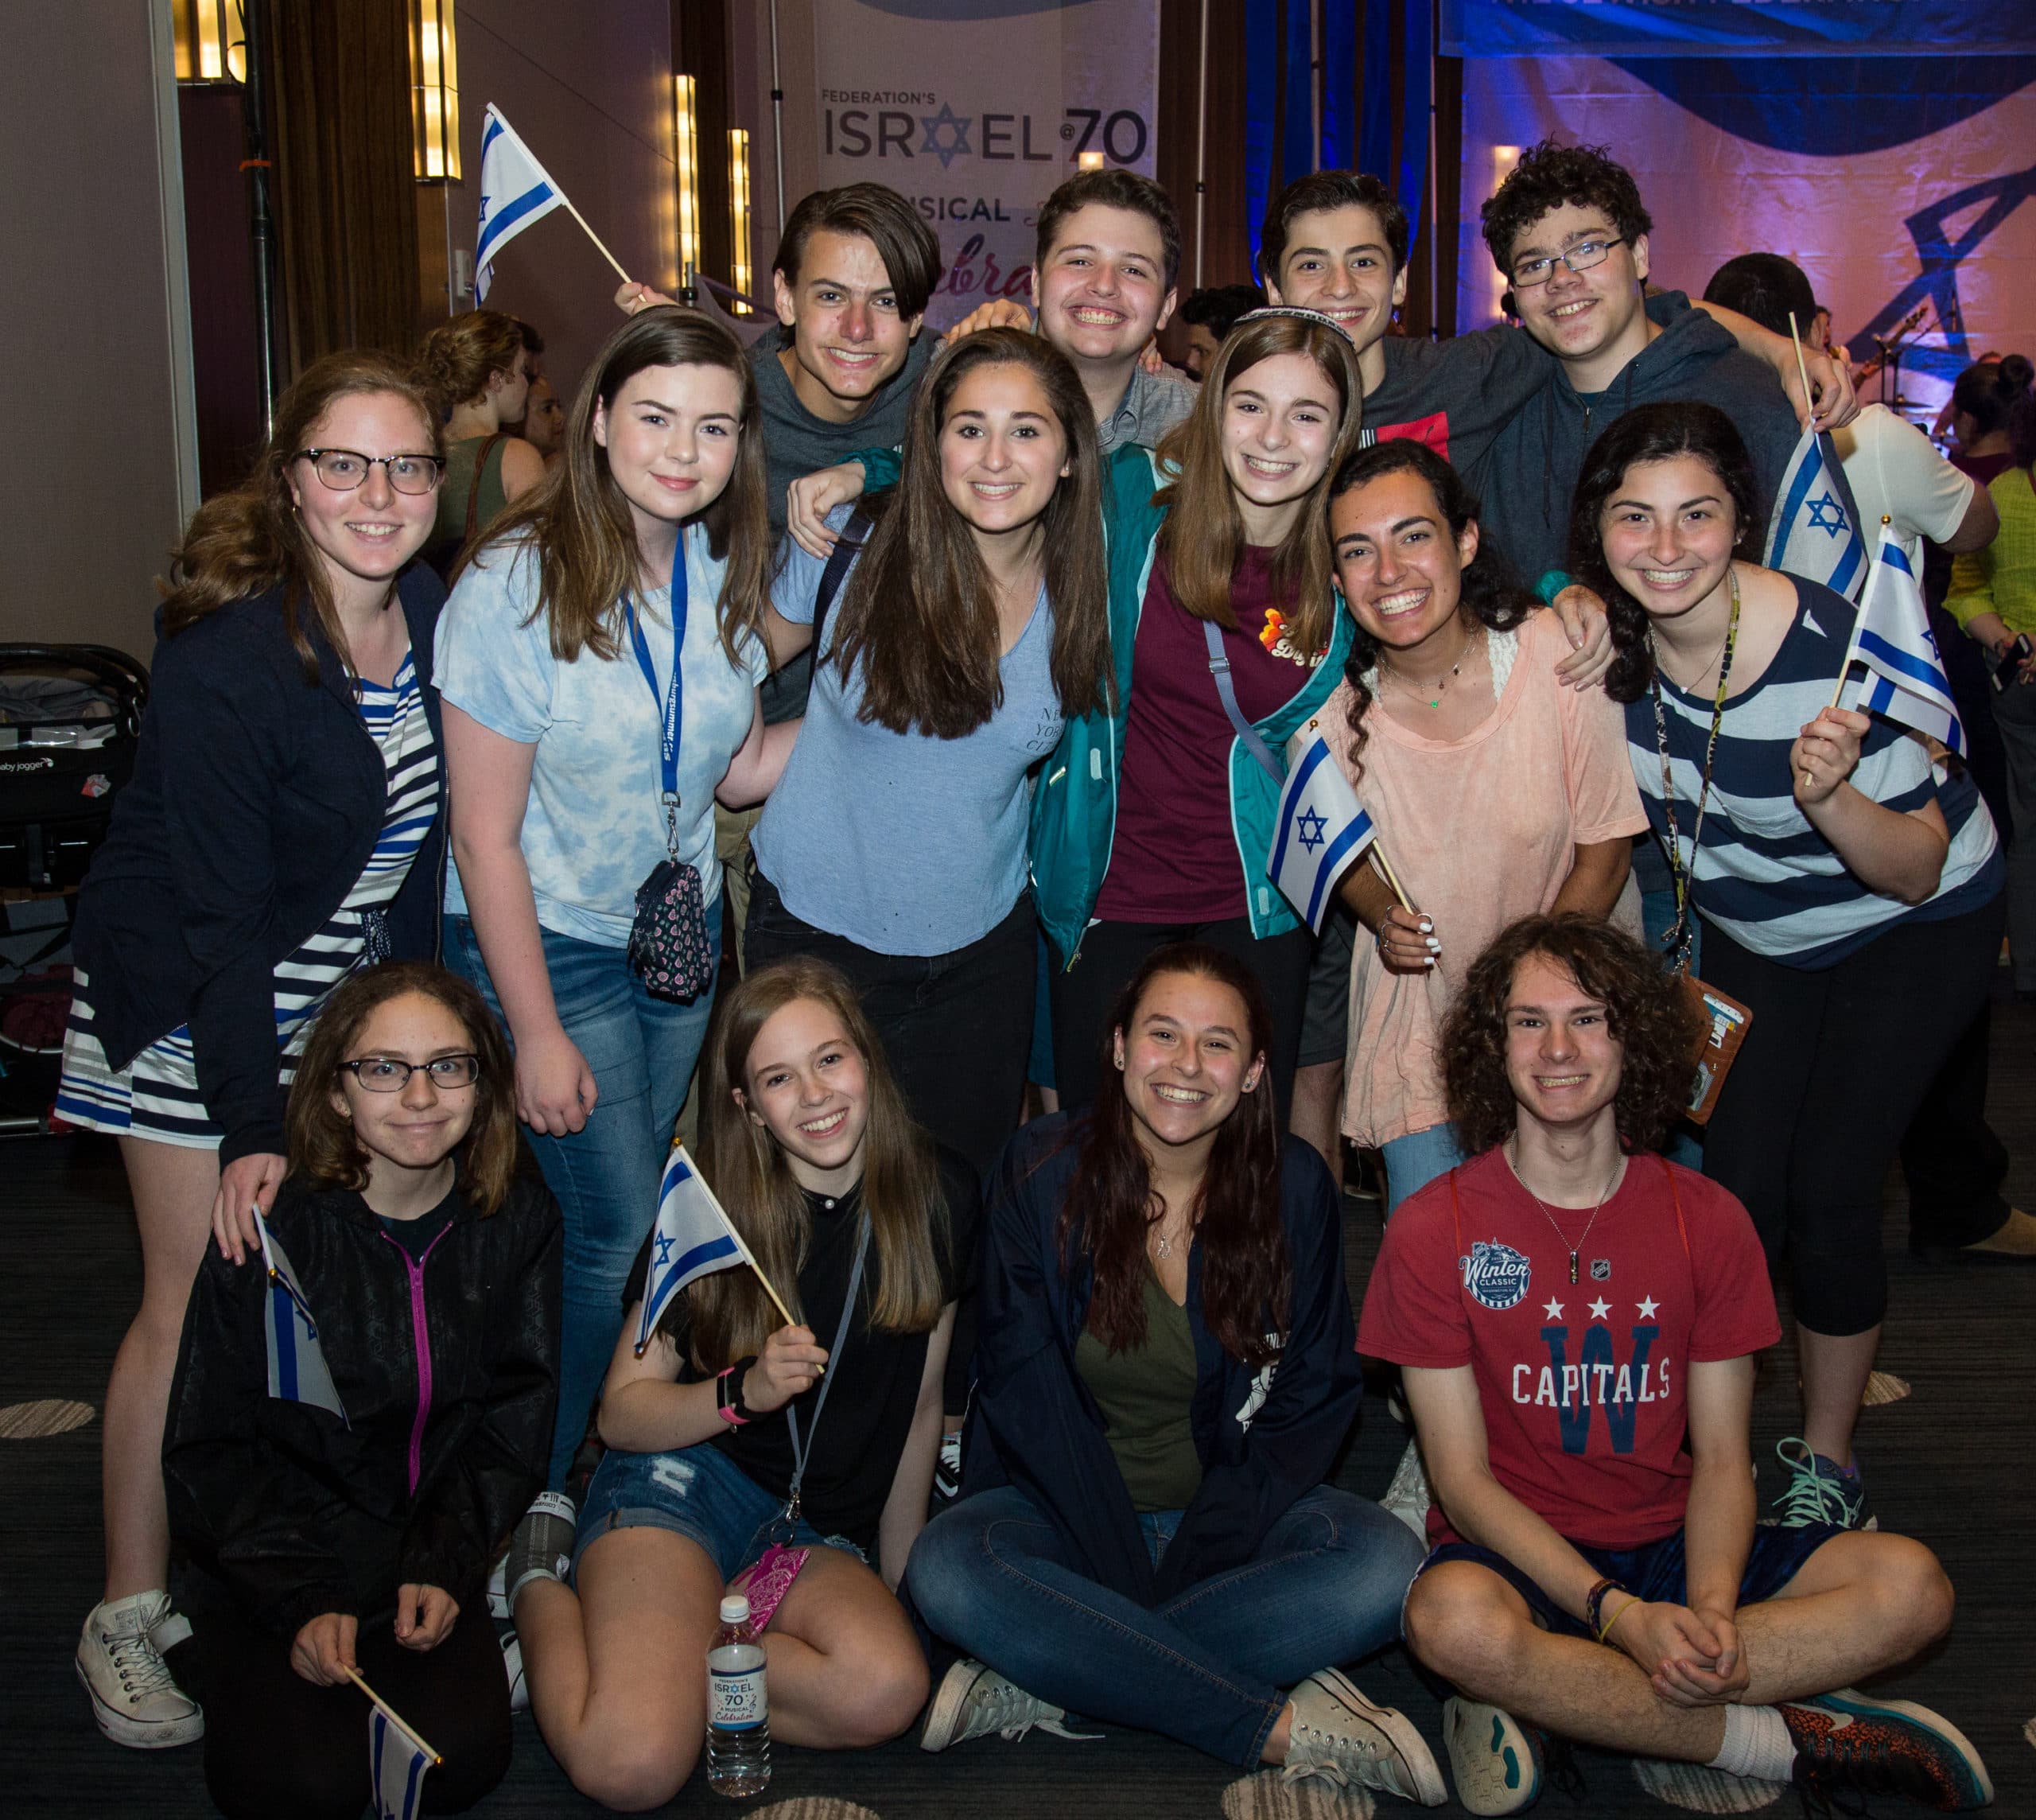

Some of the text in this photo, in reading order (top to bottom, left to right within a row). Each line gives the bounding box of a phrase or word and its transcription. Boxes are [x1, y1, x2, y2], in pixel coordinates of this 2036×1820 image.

[822, 88, 936, 105] FEDERATION'S
[16, 761, 44, 772] jogger
[1460, 1256, 1530, 1286] Winter
[1513, 1357, 1669, 1407] CAPITALS
[716, 1712, 753, 1721] Celebration
